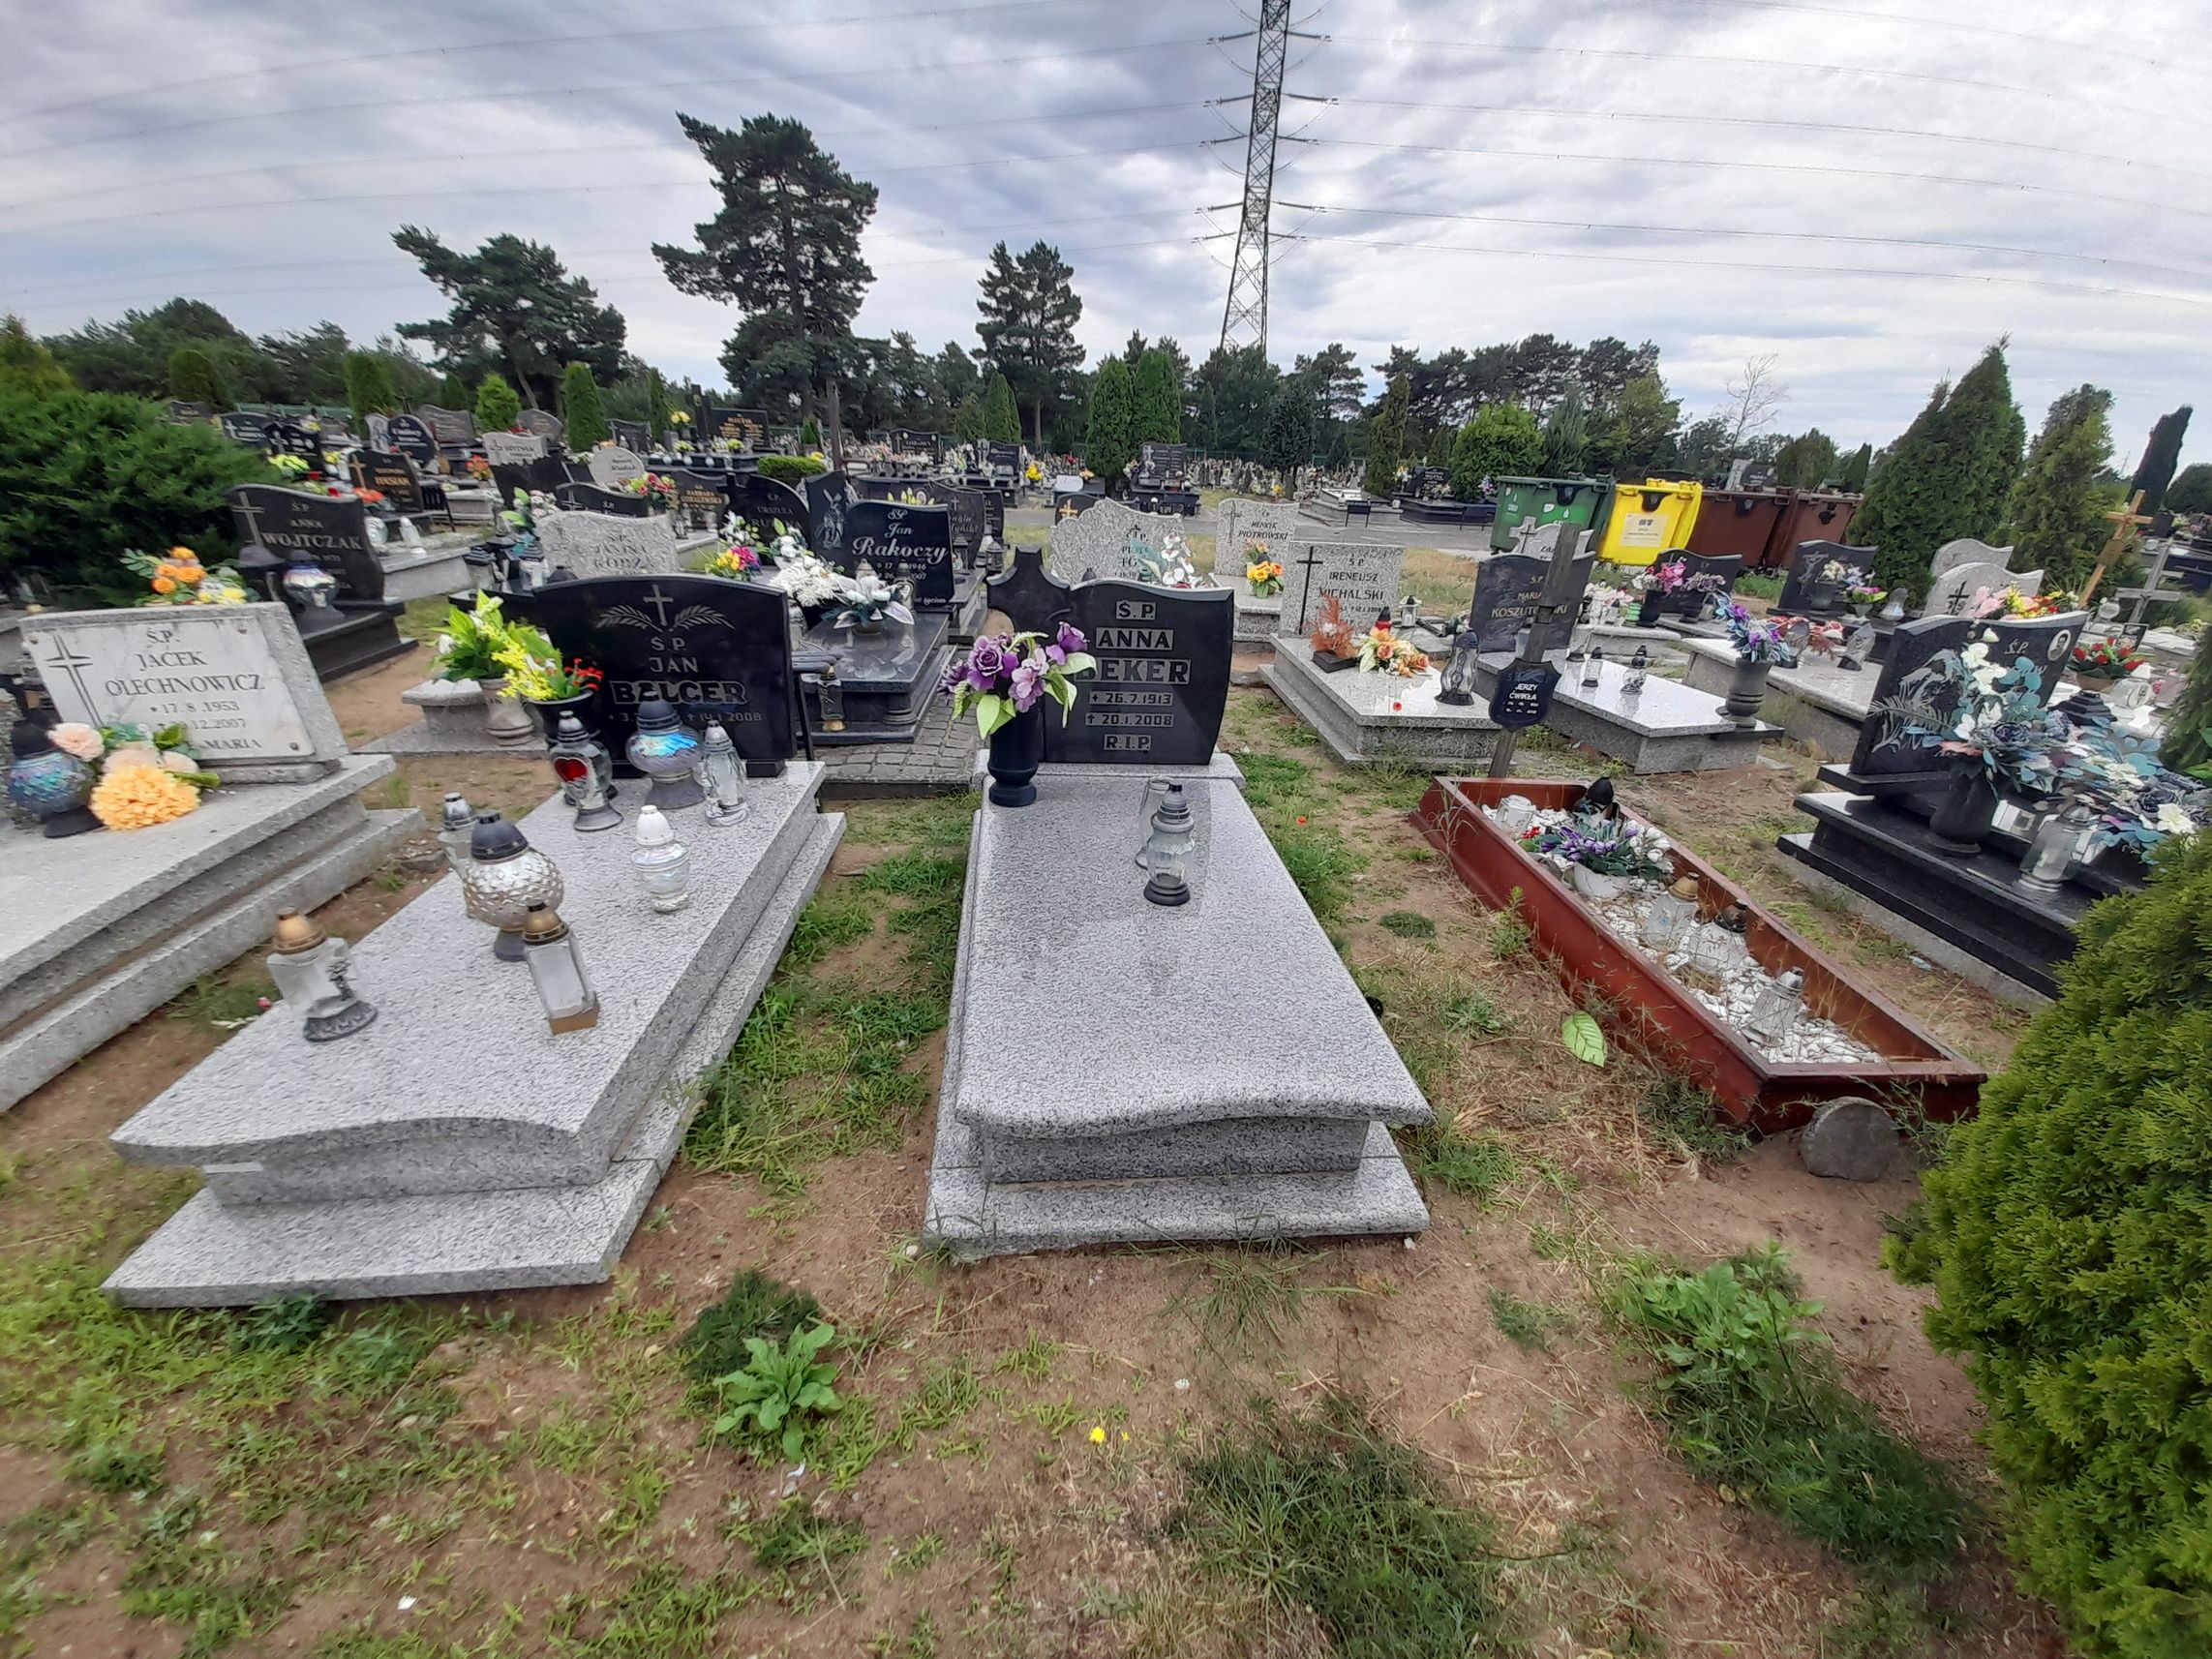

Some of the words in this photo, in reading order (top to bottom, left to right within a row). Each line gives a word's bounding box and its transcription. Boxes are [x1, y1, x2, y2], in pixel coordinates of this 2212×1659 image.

[291, 519, 324, 528] ANNA
[884, 523, 914, 538] Jan
[261, 532, 364, 550] WOJTCZAK
[1238, 530, 1288, 540] PIOTROWSKI
[852, 536, 949, 565] Rakoczy
[1329, 571, 1379, 582] IRENEUSZ
[1318, 588, 1384, 600] MICHALSKI
[1098, 629, 1170, 649] ANNA
[136, 651, 208, 671] JACEK
[649, 657, 699, 673] JAN
[106, 674, 265, 696] OLECHNOWICZ
